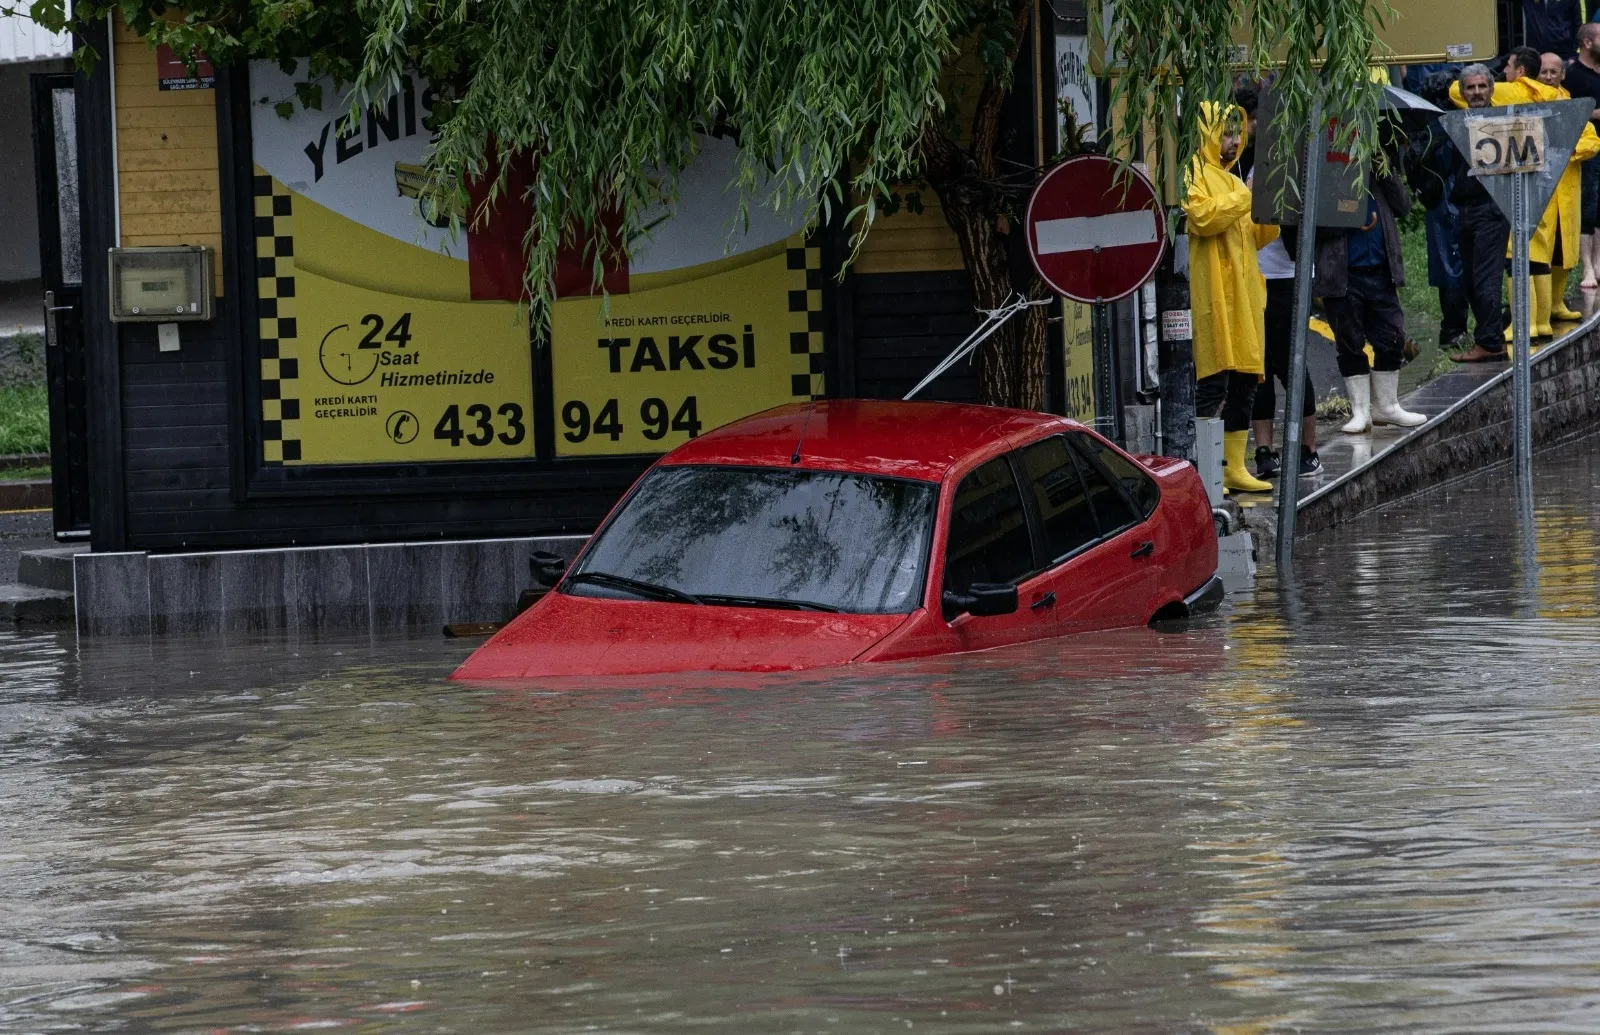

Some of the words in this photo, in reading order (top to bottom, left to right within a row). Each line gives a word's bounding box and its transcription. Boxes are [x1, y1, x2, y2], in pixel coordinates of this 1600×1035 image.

[605, 316, 635, 328] KREDİ
[638, 316, 667, 326] KARTI
[671, 312, 733, 326] GEÇERLİDİR.
[358, 312, 412, 349] 24
[598, 324, 755, 373] TAKSİ
[379, 351, 419, 366] Saat
[380, 369, 494, 388] Hizmetinizde
[314, 395, 345, 406] KREDİ
[347, 395, 377, 405] KARTI
[315, 406, 378, 419] GEÇERLİDİR
[433, 402, 526, 447] 433
[562, 399, 623, 443] 94
[640, 396, 702, 440] 94
